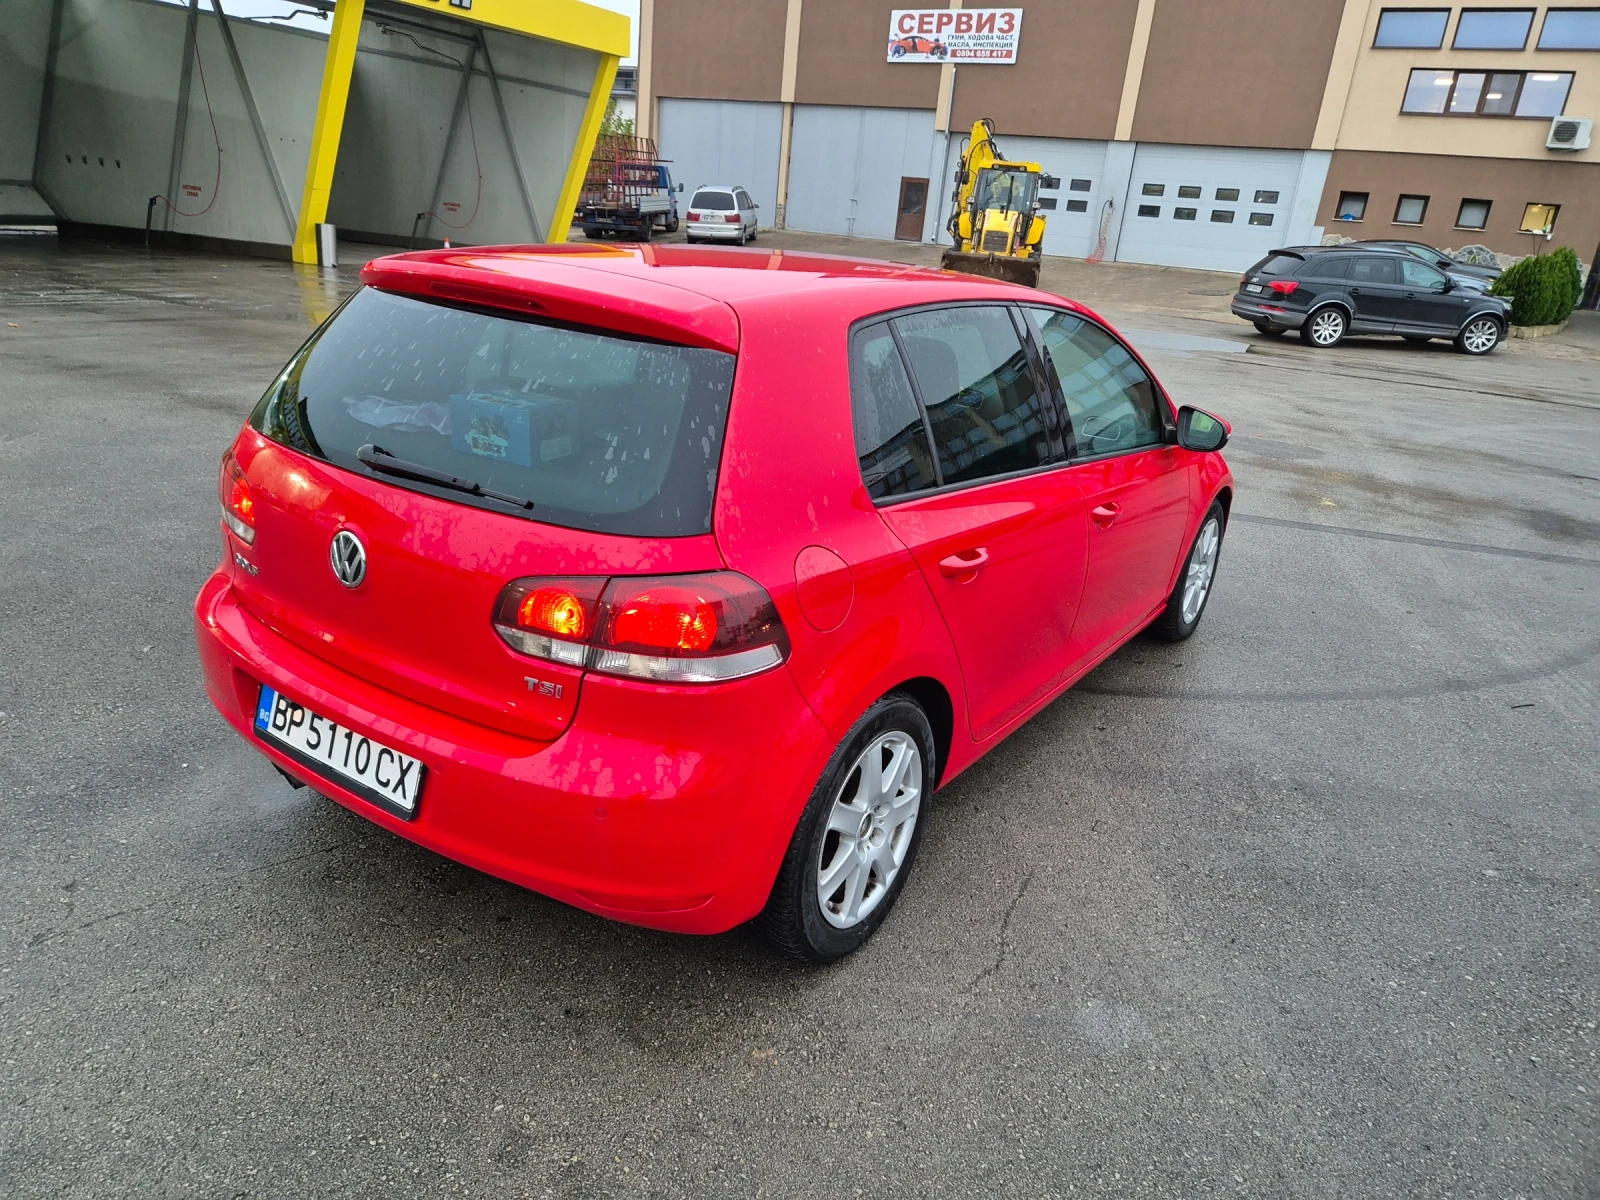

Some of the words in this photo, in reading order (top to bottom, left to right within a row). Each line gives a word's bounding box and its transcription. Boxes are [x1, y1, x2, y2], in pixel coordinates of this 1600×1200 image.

[897, 12, 1016, 34] СЕРВИЗ
[524, 675, 563, 699] TSI
[259, 708, 270, 722] BG
